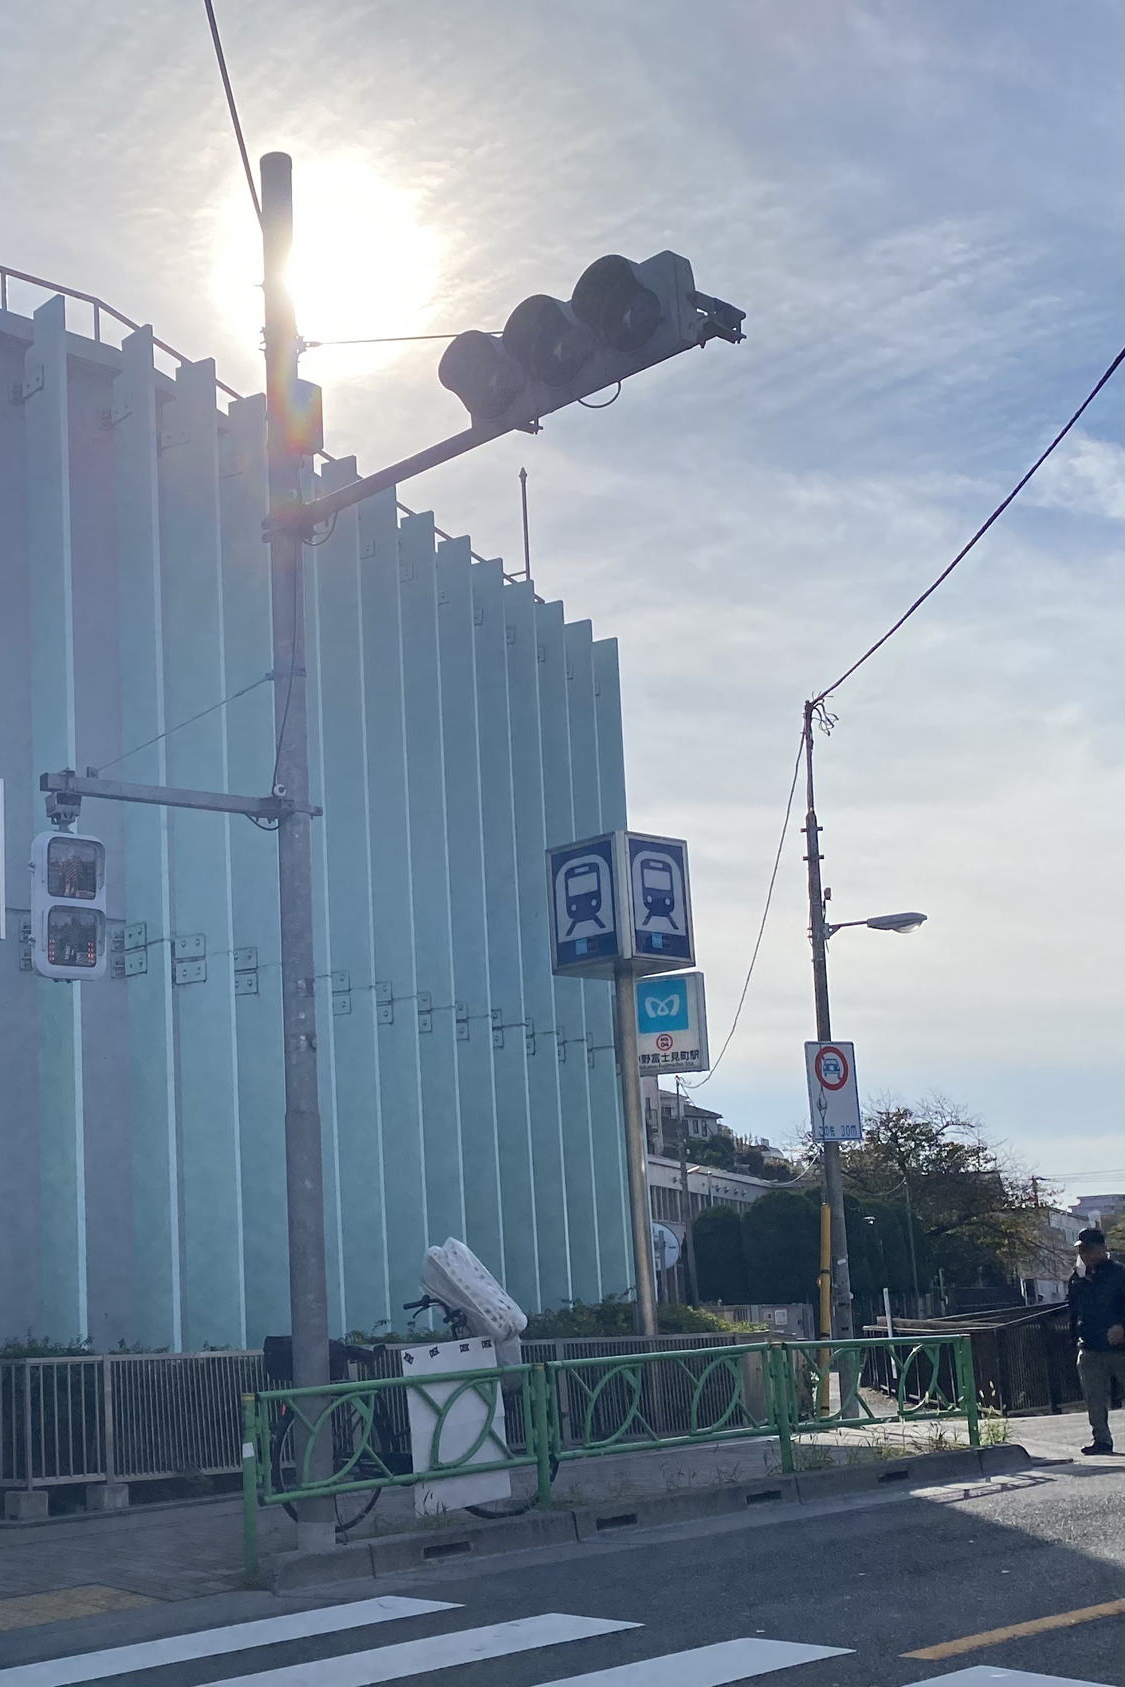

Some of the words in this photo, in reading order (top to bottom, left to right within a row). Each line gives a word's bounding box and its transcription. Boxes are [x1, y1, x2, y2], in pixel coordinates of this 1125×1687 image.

[639, 1050, 699, 1064] 野富士見町駅
[840, 1124, 857, 1137] 30m
